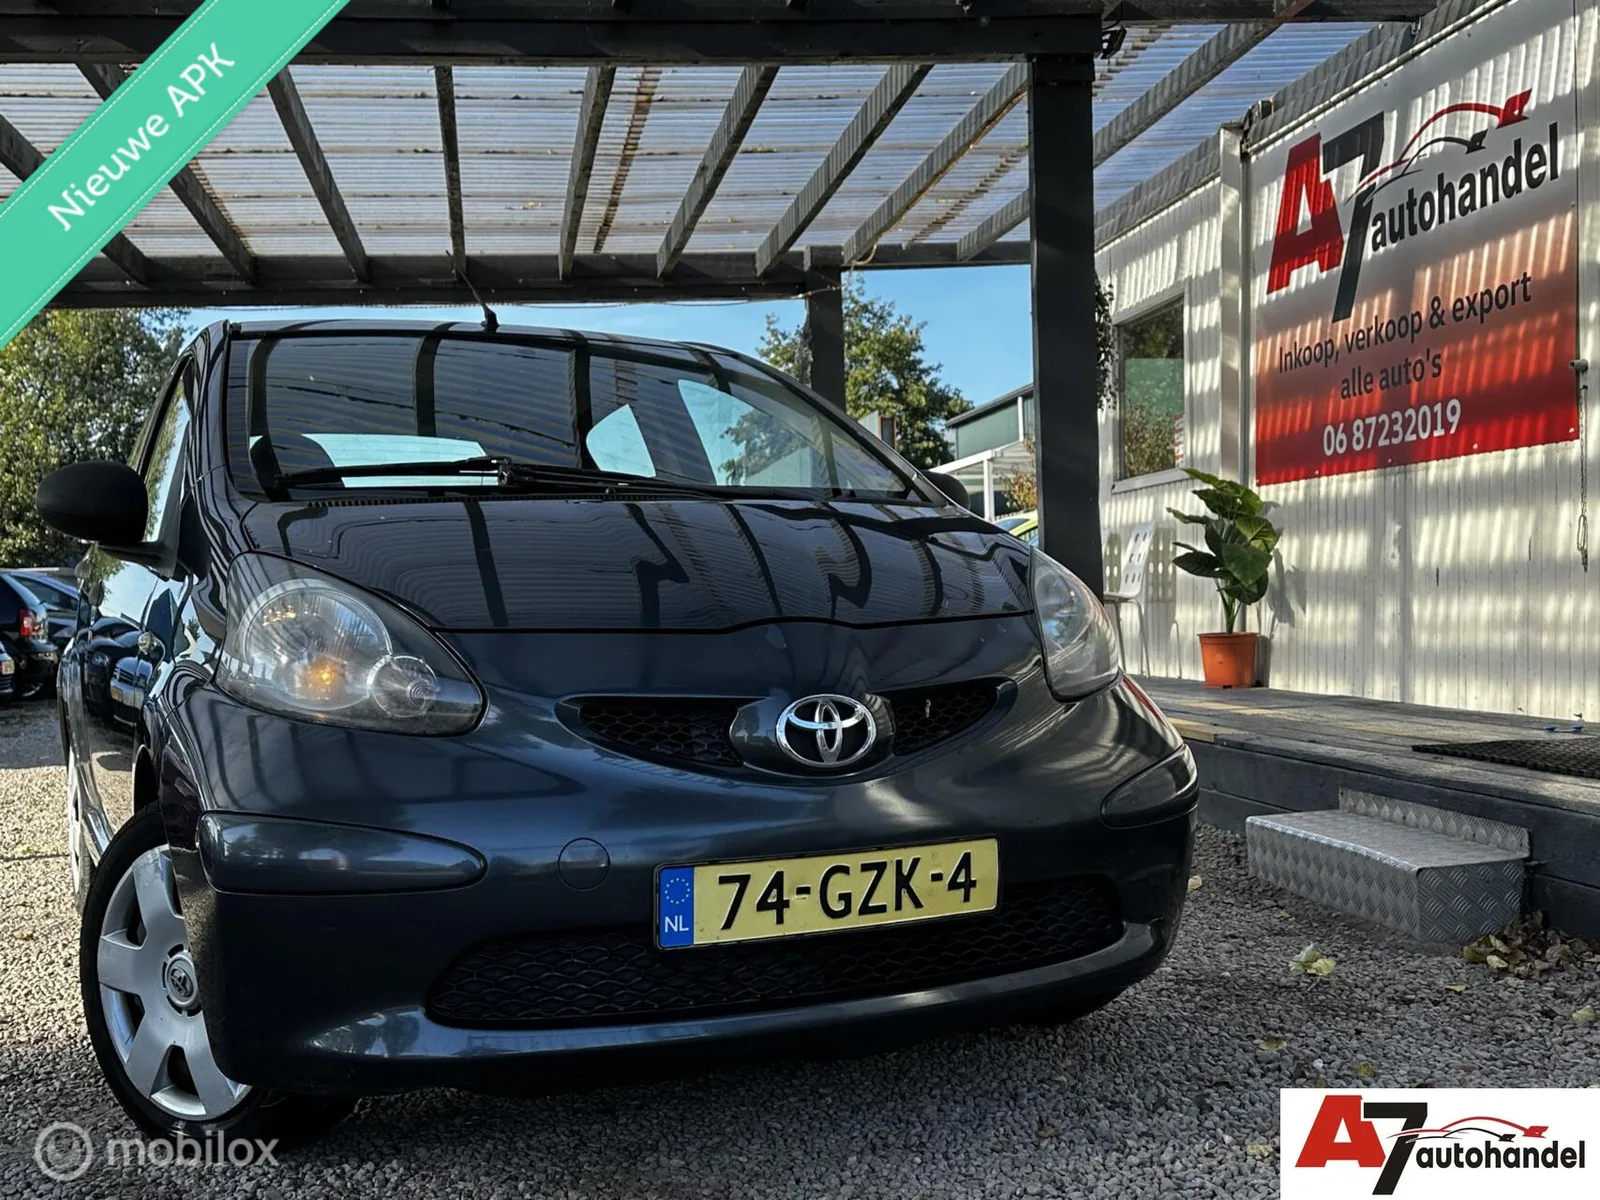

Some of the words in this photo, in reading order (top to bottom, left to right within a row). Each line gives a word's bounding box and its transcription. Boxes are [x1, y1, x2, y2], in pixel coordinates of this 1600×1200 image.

[1266, 111, 1385, 323] A7
[1371, 121, 1559, 252] autohandel
[1279, 339, 1339, 373] Inkoop,
[1345, 312, 1422, 355] verkoop
[1429, 296, 1446, 329] &
[1452, 272, 1532, 324] export
[1340, 366, 1374, 400] alle
[1380, 348, 1442, 392] auto's
[1323, 422, 1348, 456] 06
[1352, 399, 1461, 450] 87232019
[664, 915, 689, 932] NL
[718, 851, 977, 931] 74-GZK-4
